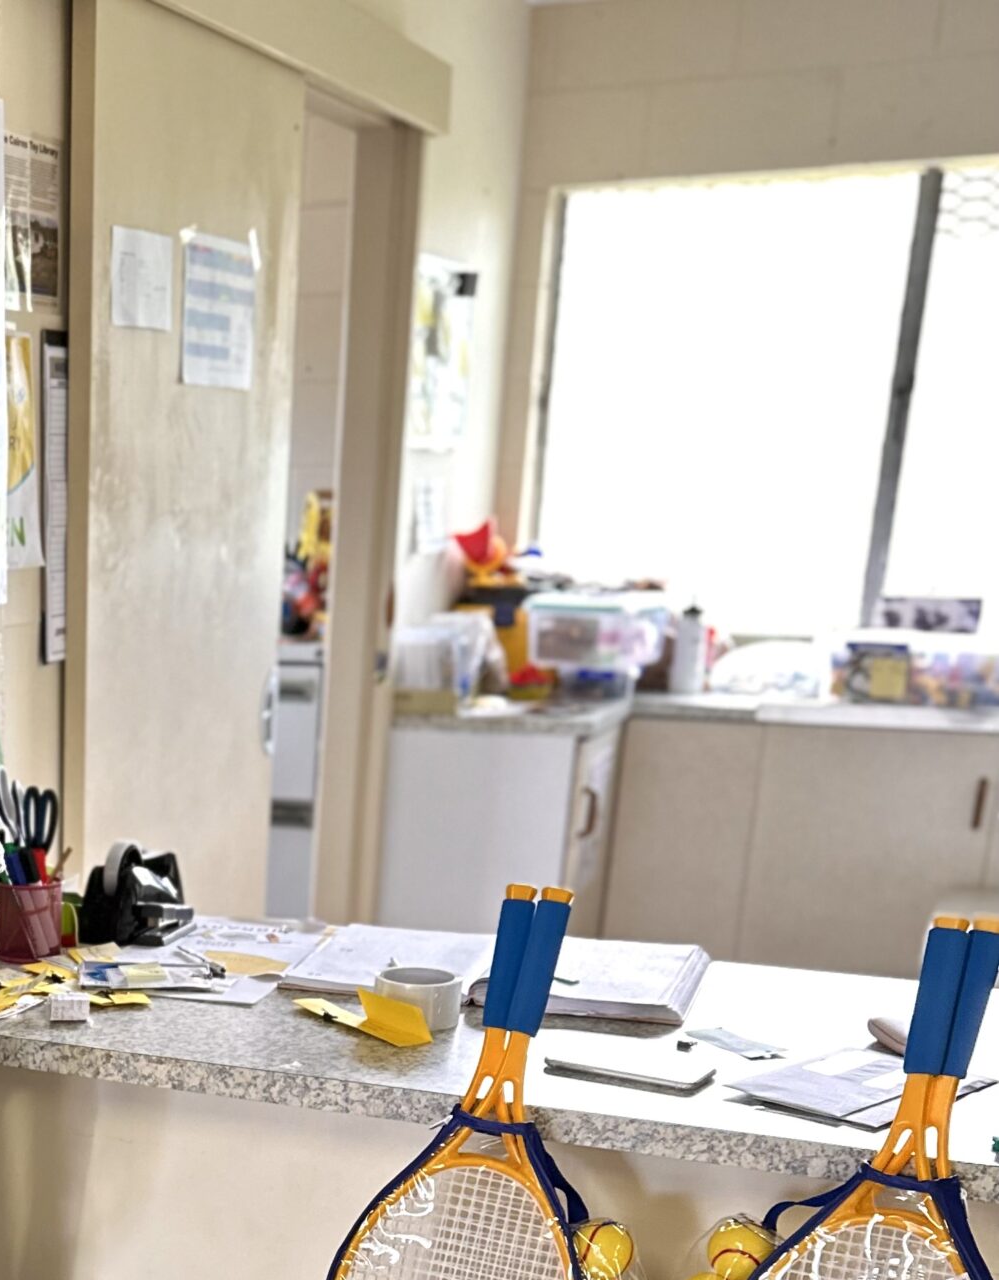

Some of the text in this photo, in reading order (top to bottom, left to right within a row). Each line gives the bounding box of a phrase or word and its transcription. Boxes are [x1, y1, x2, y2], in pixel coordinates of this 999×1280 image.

[9, 135, 28, 149] Cairns
[29, 140, 38, 154] Toy
[39, 144, 59, 160] Library
